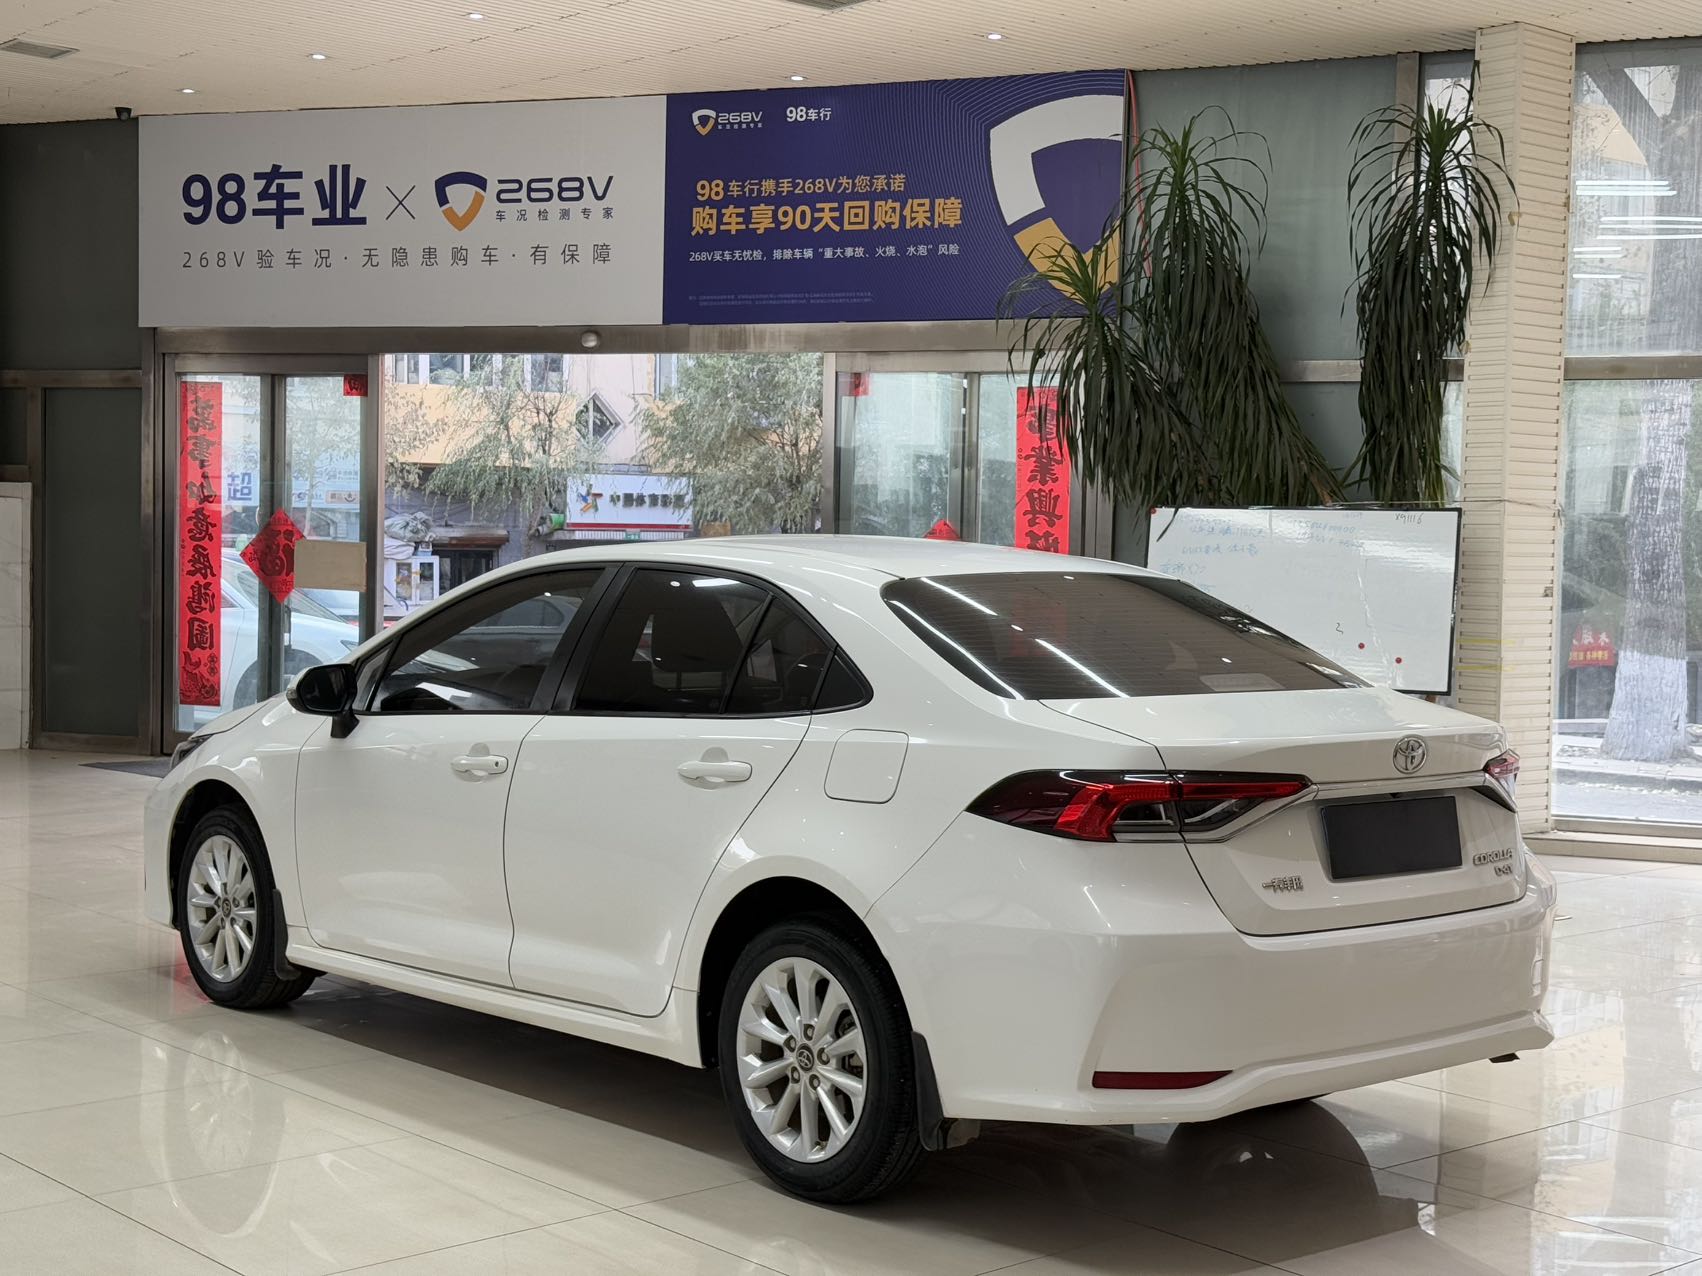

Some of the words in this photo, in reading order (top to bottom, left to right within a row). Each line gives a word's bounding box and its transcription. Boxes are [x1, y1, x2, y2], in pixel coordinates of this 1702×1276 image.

[718, 111, 763, 122] 268V
[786, 106, 832, 122] 98车行
[182, 164, 367, 229] 98车业
[496, 175, 613, 204] 268V
[696, 173, 906, 201] 98车行携手268V为您承诺
[496, 207, 613, 222] 车况检测专家
[691, 197, 962, 236] 购车享90天回购保障
[227, 472, 252, 501] 超
[1473, 848, 1513, 866] COROLLA
